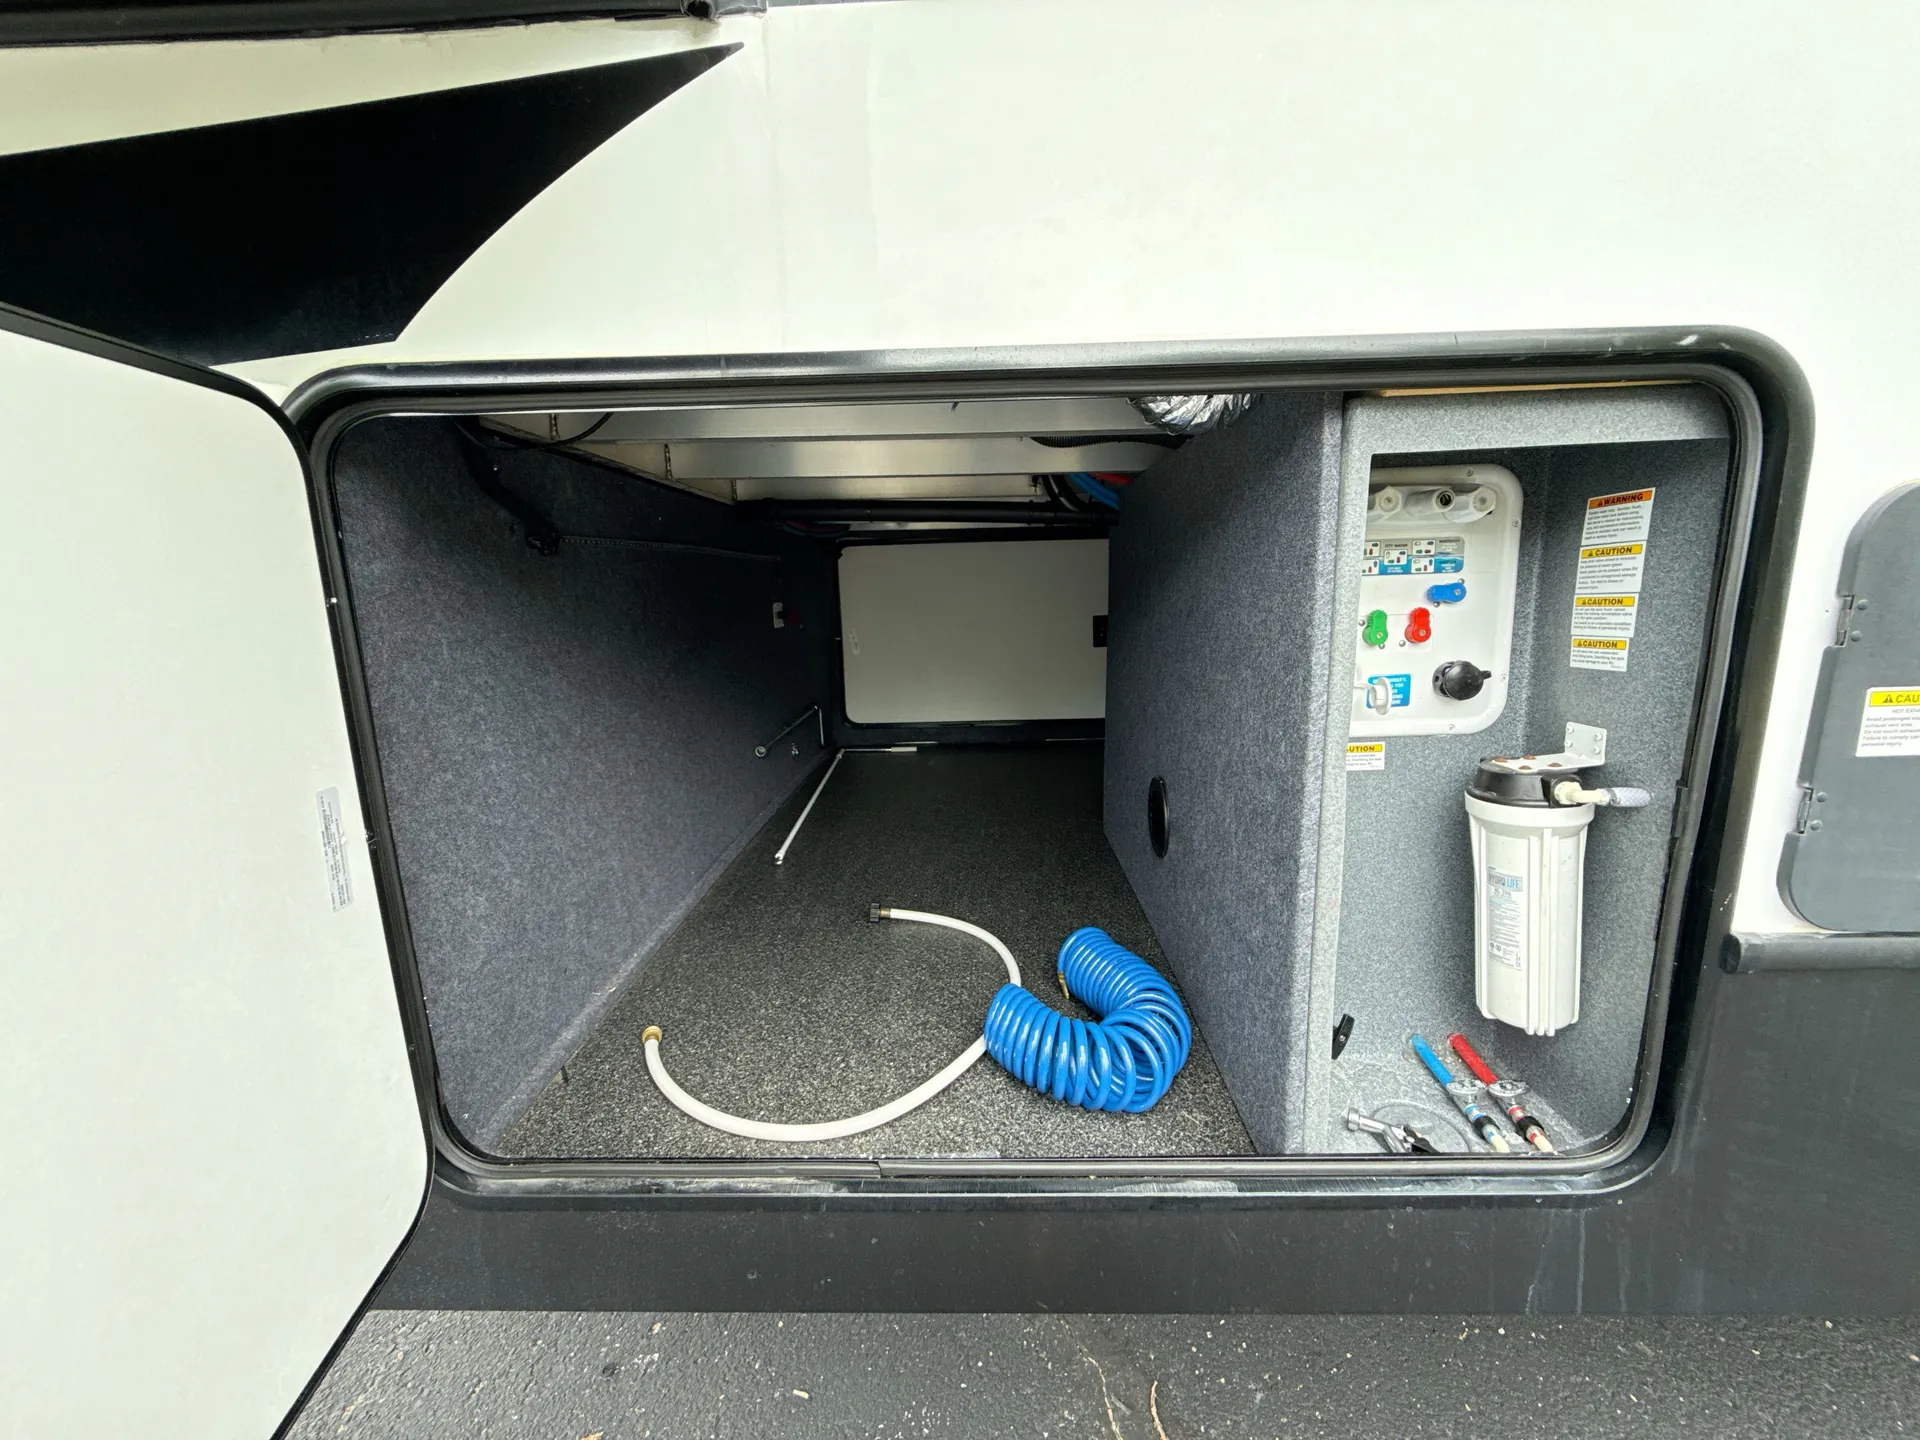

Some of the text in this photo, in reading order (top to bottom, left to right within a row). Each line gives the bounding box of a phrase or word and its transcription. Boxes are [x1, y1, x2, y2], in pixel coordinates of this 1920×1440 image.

[1604, 493, 1644, 505] WARNING
[1595, 546, 1632, 557] CAUTION
[1582, 640, 1618, 648] CAUTION
[1506, 878, 1520, 889] LIFE
